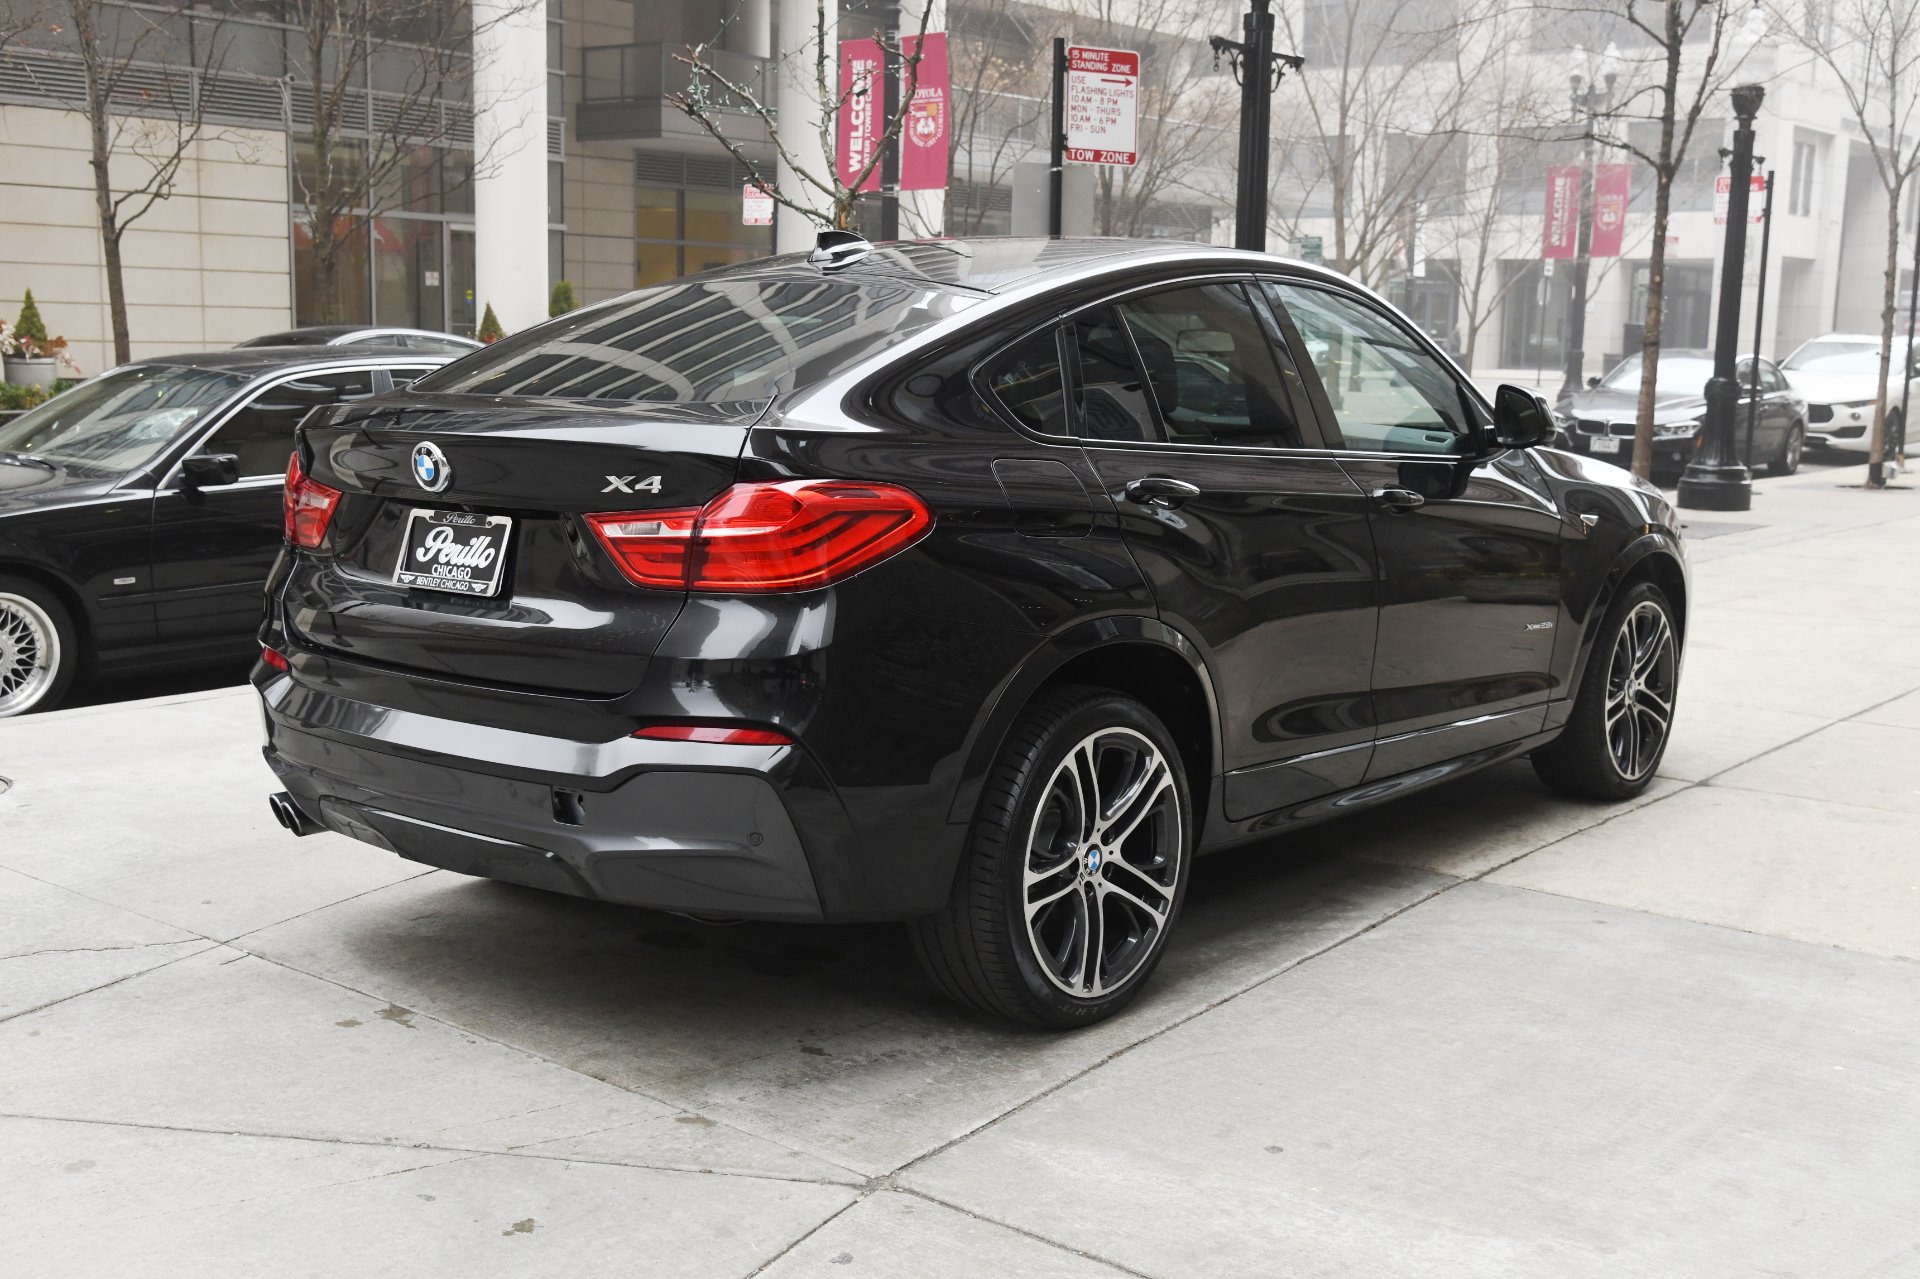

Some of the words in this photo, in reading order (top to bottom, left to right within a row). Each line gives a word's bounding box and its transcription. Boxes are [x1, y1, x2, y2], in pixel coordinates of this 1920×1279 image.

[1072, 50, 1080, 59] 15
[1082, 51, 1109, 61] MINUTE
[1072, 61, 1108, 71] STANDING
[1112, 63, 1131, 73] ZONE
[1072, 76, 1086, 84] USE
[1071, 85, 1107, 96] FLASHING
[1109, 88, 1134, 98] LIGHTS
[849, 60, 865, 173] WELCOME
[1071, 105, 1087, 113] MON
[1096, 107, 1121, 116] THURS
[1070, 124, 1083, 132] FRI
[1090, 125, 1106, 134] SUN
[1070, 150, 1095, 161] TOW
[1100, 151, 1130, 164] ZONE
[600, 475, 662, 493] X4
[443, 513, 476, 524] Perillo
[416, 526, 496, 569] Perillo
[431, 564, 472, 580] CHICAGO
[416, 577, 441, 587] BENTLEY
[440, 579, 469, 591] CHICAGO
